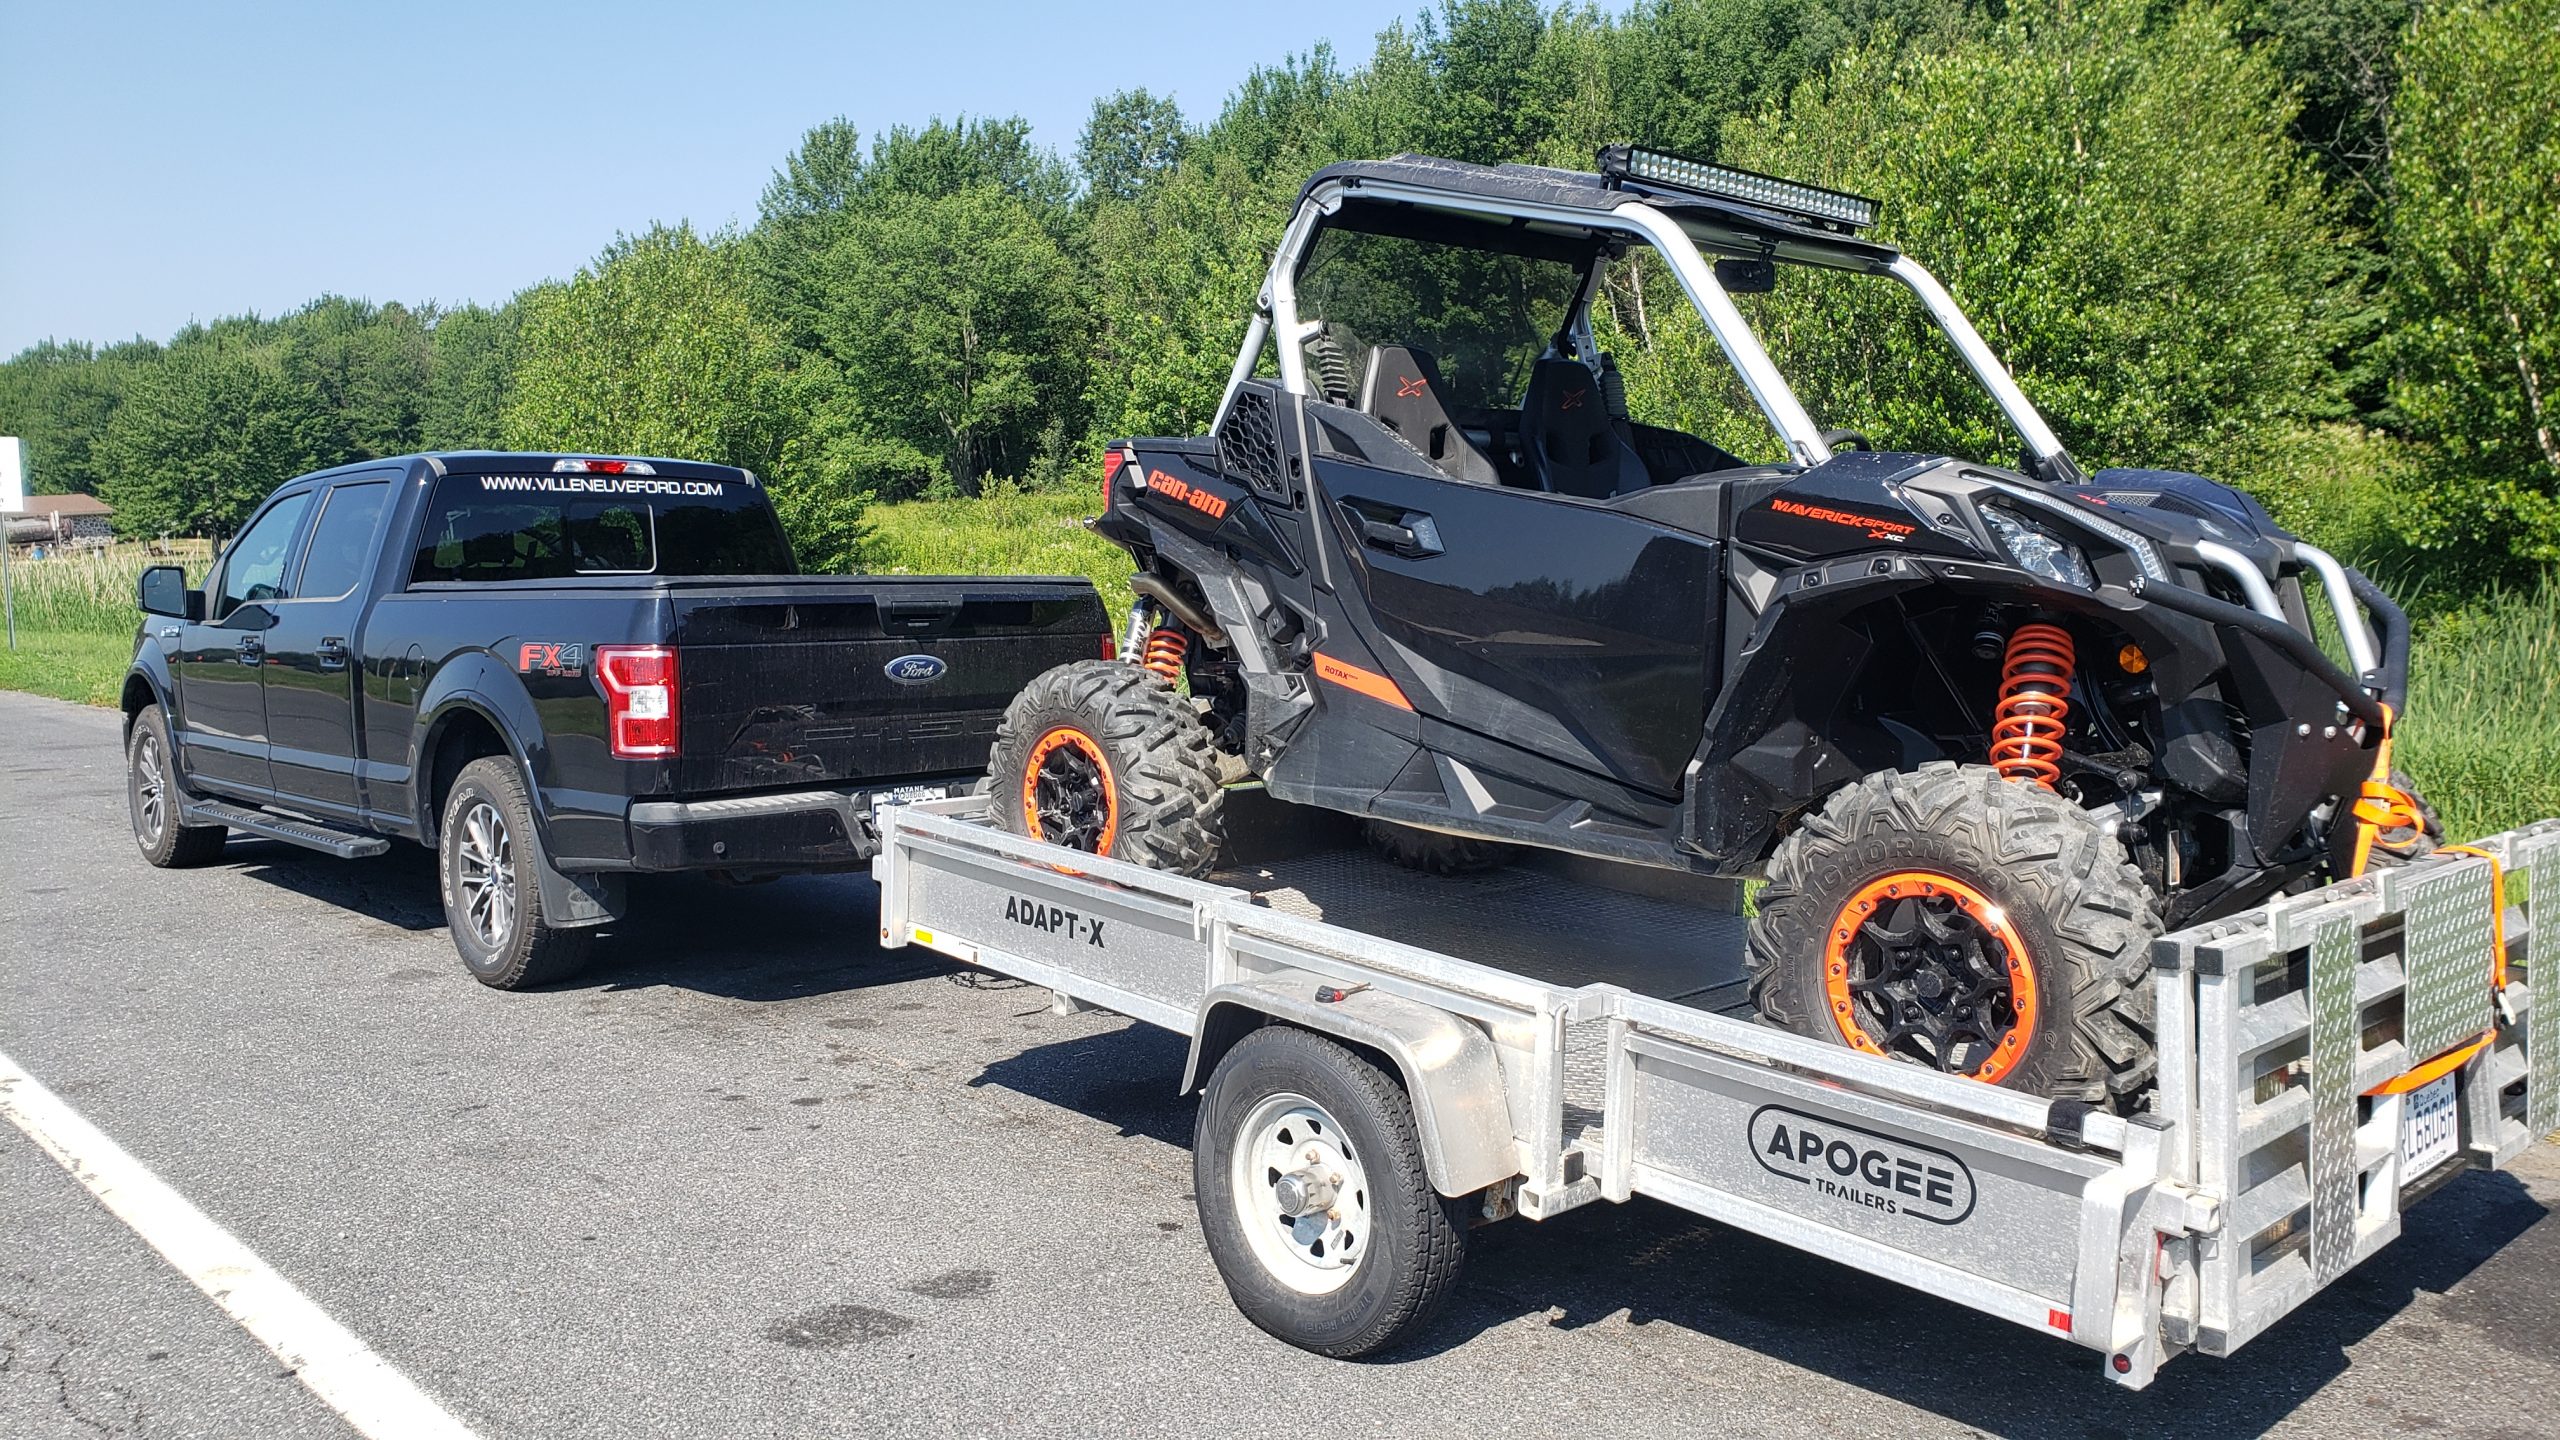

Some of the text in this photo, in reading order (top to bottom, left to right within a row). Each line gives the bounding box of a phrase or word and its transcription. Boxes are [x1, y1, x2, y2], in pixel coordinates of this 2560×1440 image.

[480, 476, 723, 496] WWW.VILLENEUVEFORD.COM
[1148, 469, 1227, 519] can-am
[520, 642, 583, 673] FX4
[900, 660, 934, 677] Ford
[1324, 665, 1349, 680] ROTAX
[893, 785, 925, 794] MATANE
[443, 787, 475, 907] GOODYEAR
[1797, 837, 1947, 922] BIGHORN
[1005, 895, 1105, 949] ADAPT-X
[1767, 1124, 1955, 1208] APOGEE
[1815, 1177, 1897, 1214] TRAILERS
